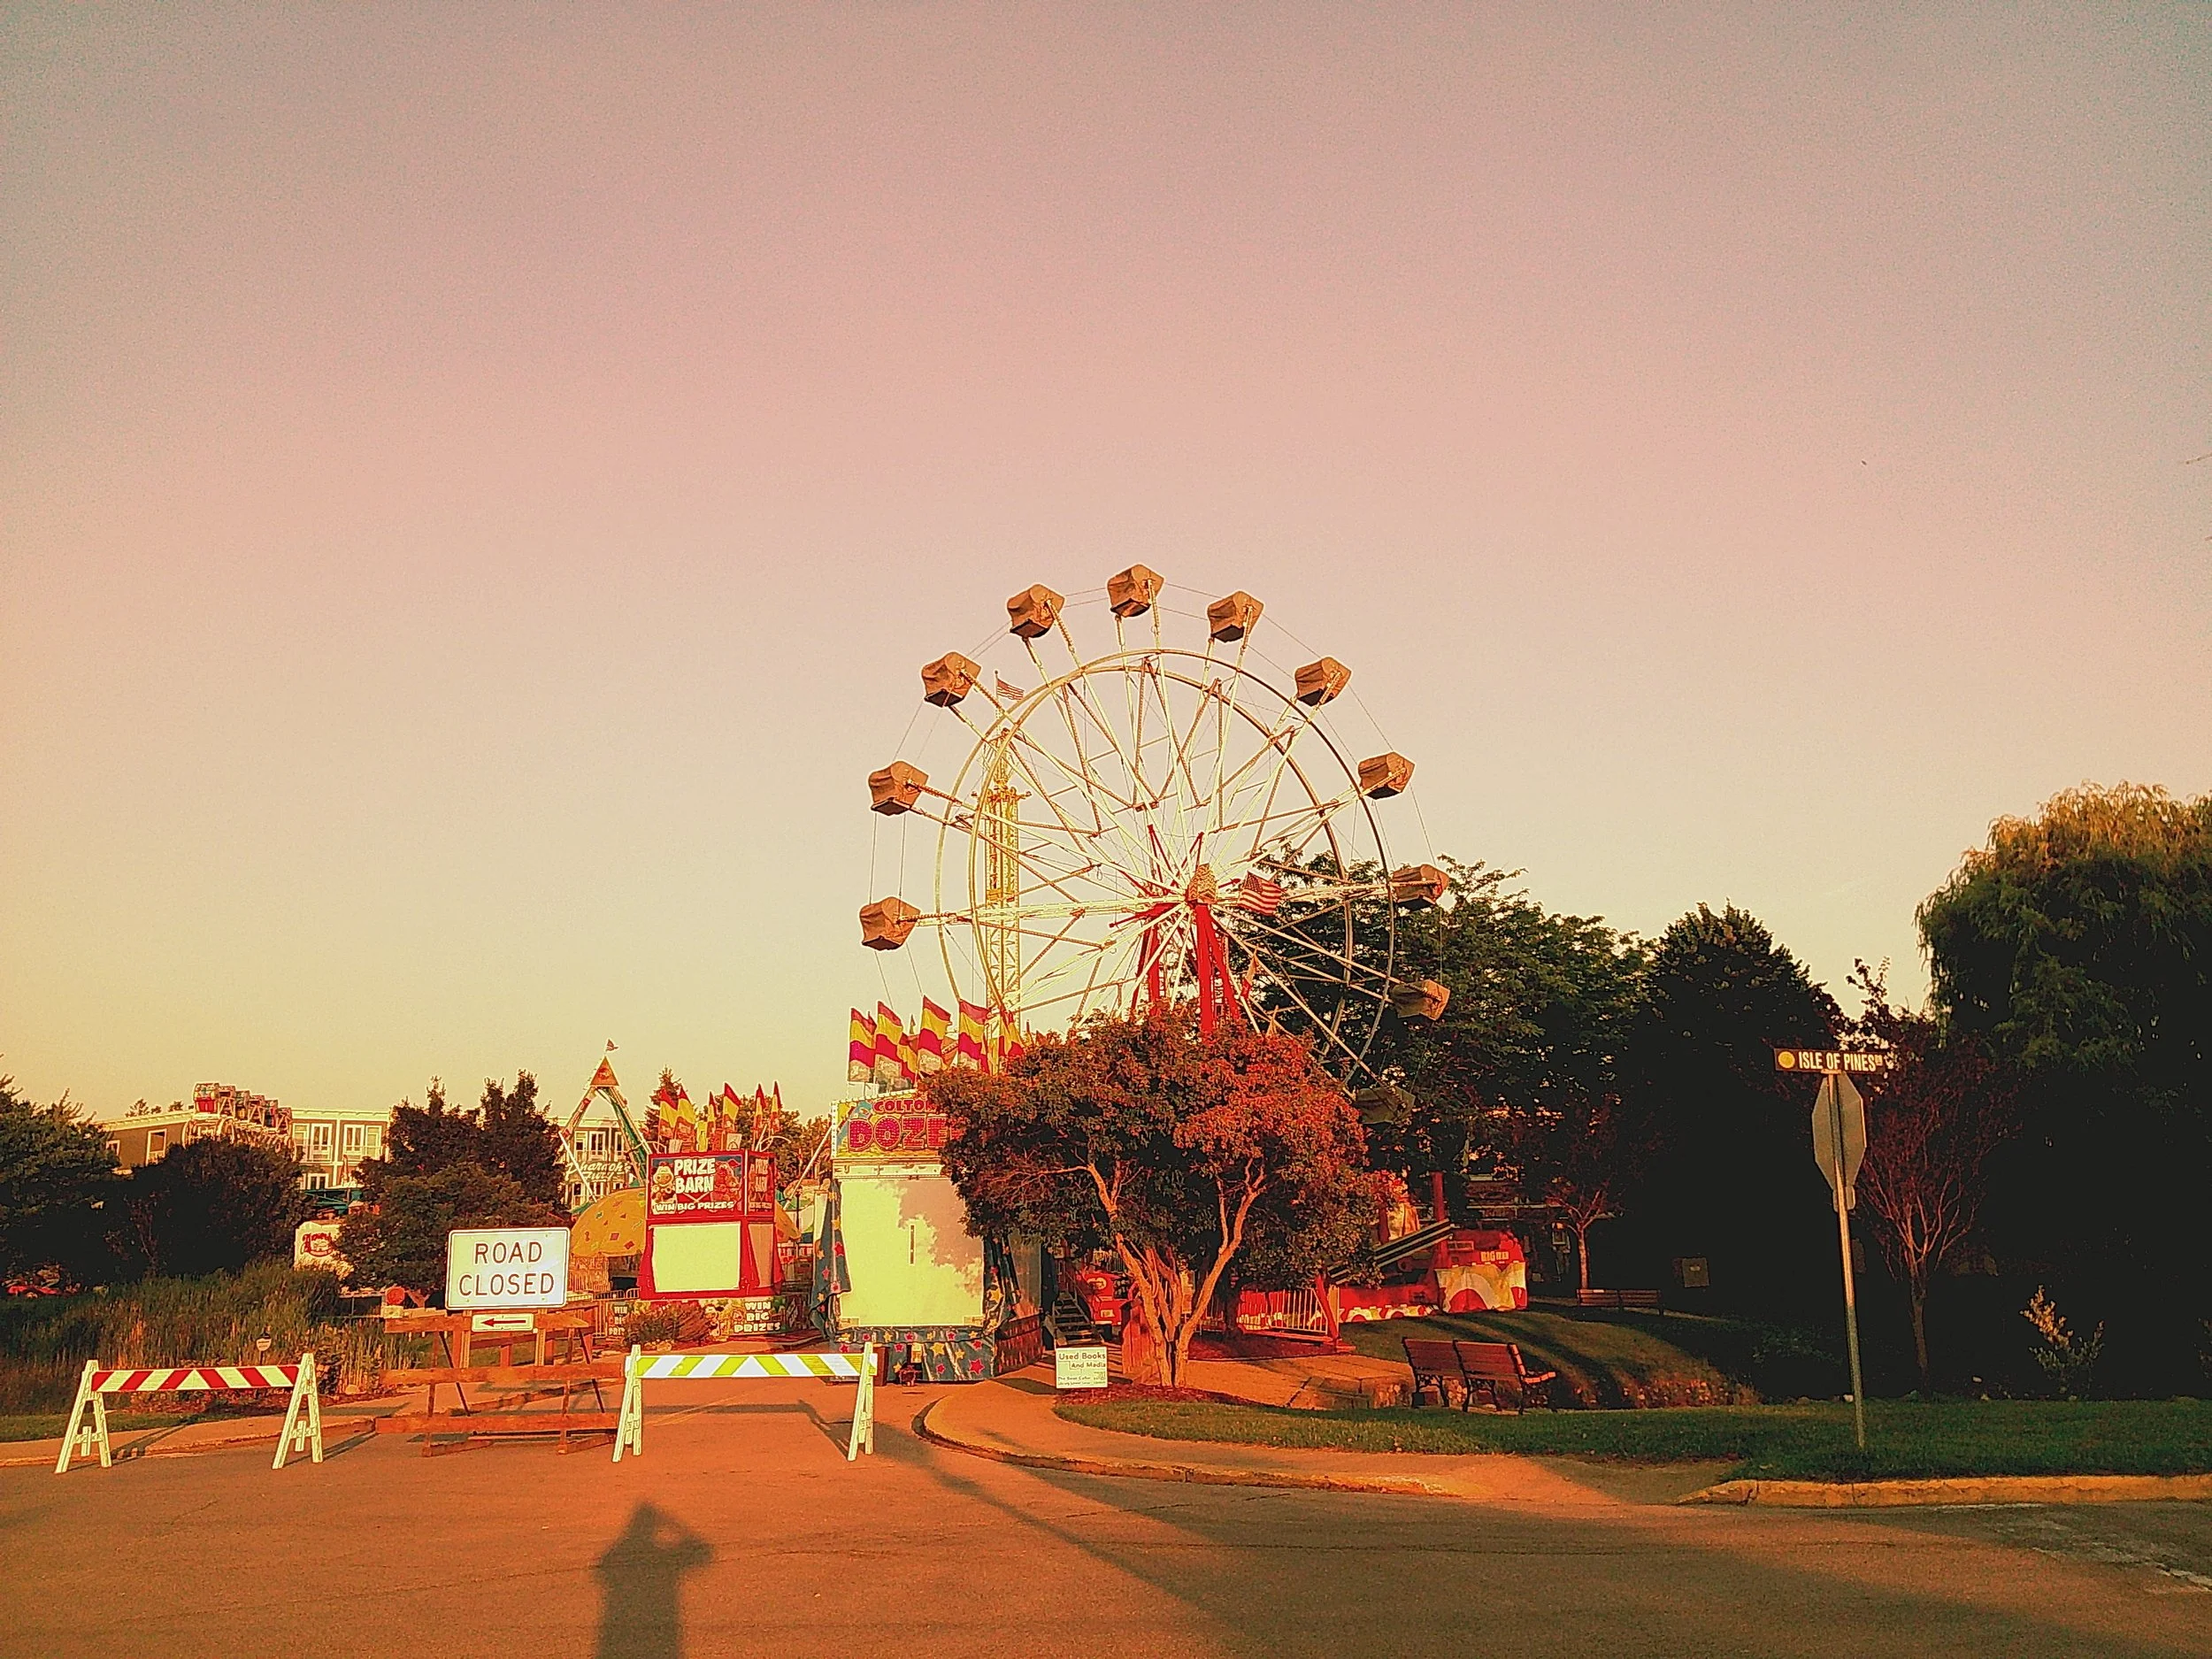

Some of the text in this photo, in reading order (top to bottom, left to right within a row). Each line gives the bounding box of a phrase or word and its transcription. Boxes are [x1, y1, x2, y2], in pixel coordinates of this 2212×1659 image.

[1798, 1051, 1823, 1070] ISLE
[1825, 1052, 1841, 1070] OF
[1843, 1053, 1877, 1072] PINES
[673, 1157, 716, 1176] PRIZE
[675, 1176, 715, 1194] BARN
[655, 1201, 735, 1211] WIN BIG PRIZES
[474, 1241, 542, 1264] ROAD
[458, 1272, 555, 1296] CLOSED
[744, 1302, 772, 1311] WIN
[746, 1311, 770, 1322] BIG
[734, 1322, 781, 1333] PRIZES
